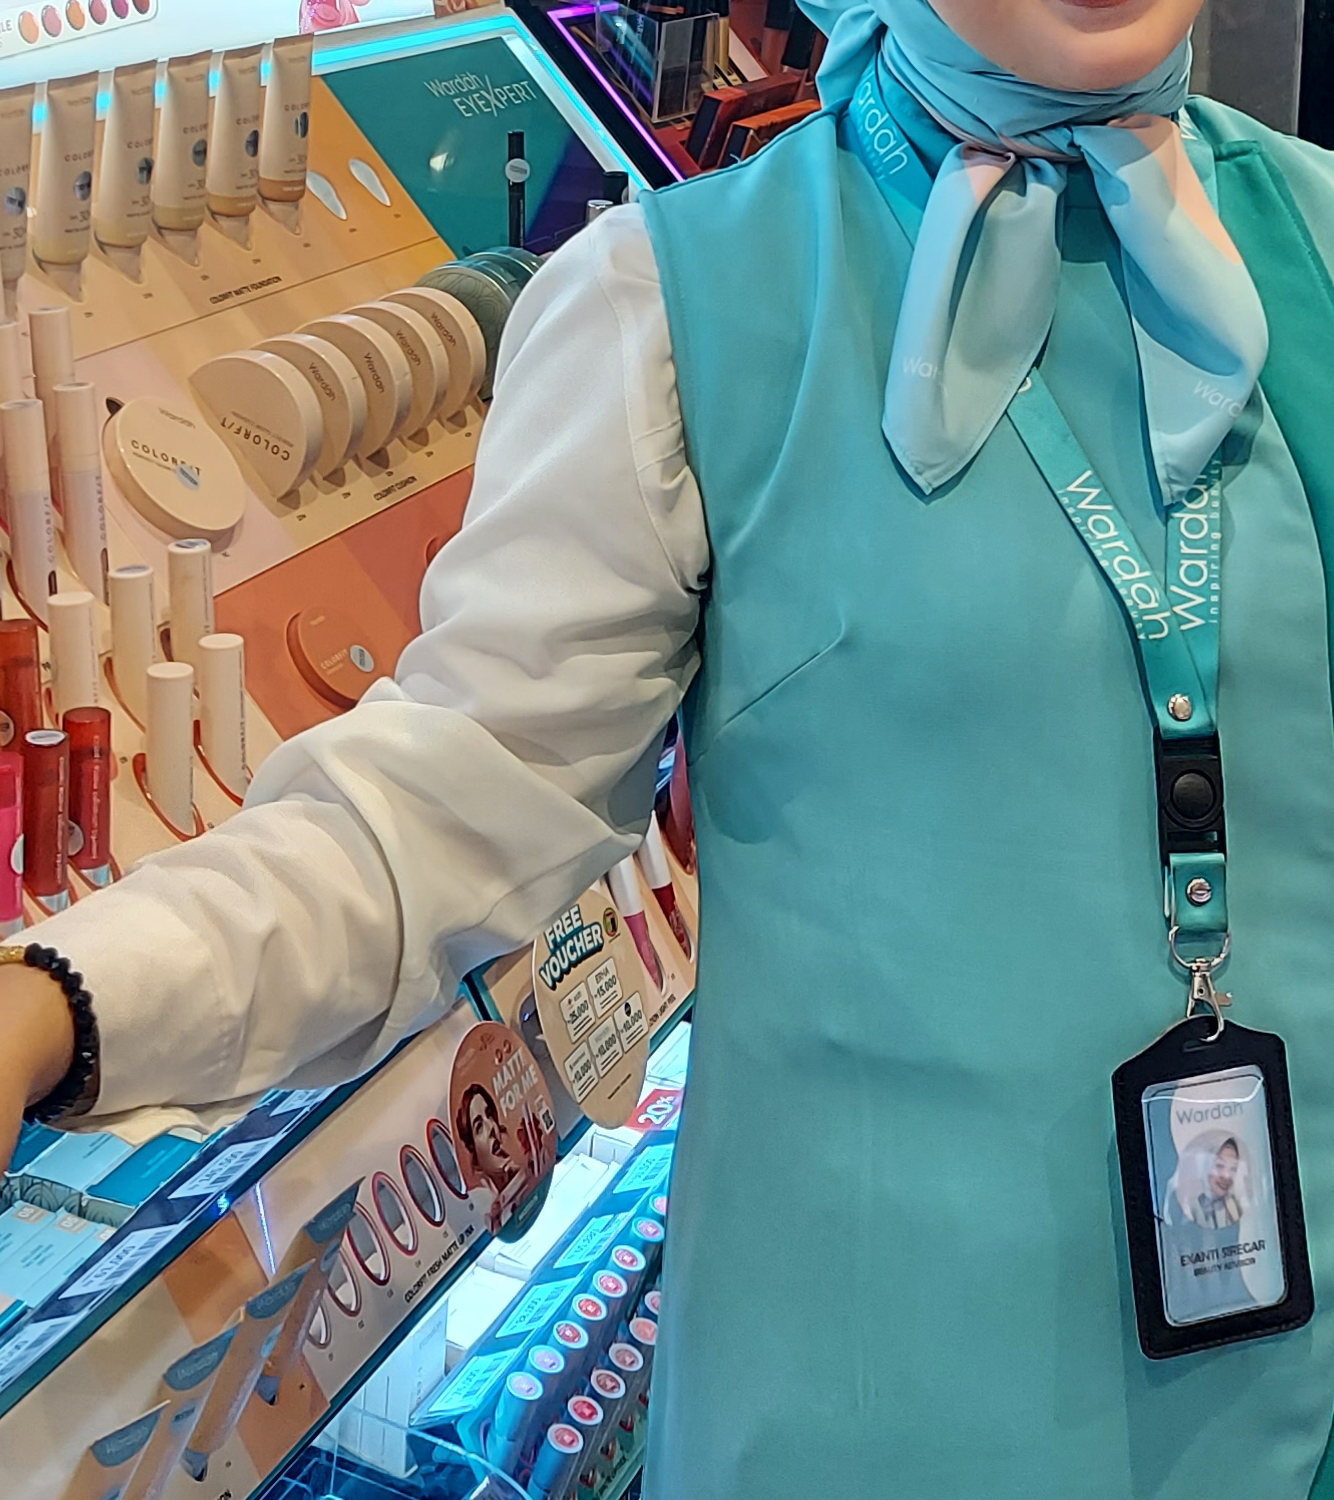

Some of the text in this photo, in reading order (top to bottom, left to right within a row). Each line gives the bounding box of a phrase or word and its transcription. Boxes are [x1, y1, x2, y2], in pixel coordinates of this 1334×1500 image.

[453, 74, 537, 118] EYEXPERT
[1208, 532, 1222, 623] inspiring
[545, 904, 583, 950] FREE
[540, 924, 603, 989] VOUCHER
[500, 1064, 538, 1117] FOR ME
